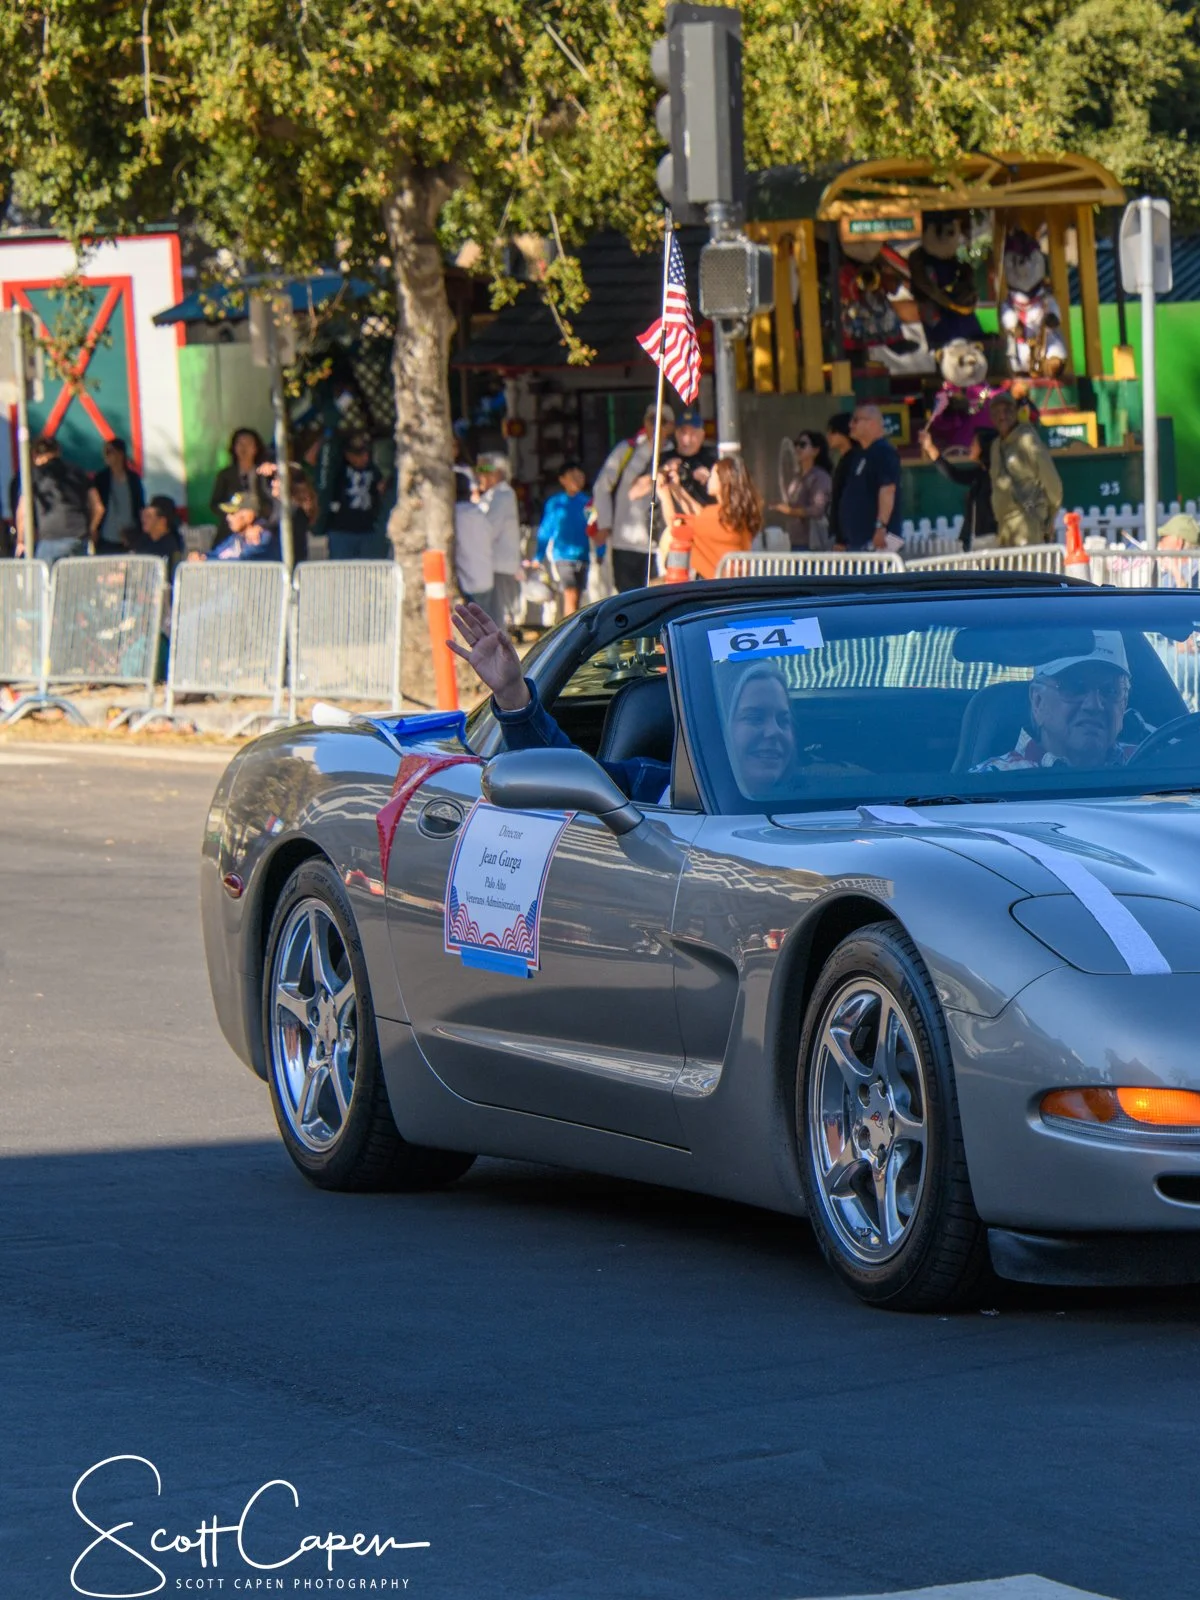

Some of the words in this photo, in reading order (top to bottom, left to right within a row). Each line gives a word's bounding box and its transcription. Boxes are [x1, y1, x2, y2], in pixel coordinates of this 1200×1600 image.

[729, 628, 792, 652] 64
[499, 824, 524, 840] Director
[478, 847, 497, 867] Jean
[498, 849, 522, 874] Gurga
[484, 876, 496, 889] Palo
[496, 878, 507, 891] Alto
[465, 890, 485, 905] Veterans
[486, 895, 521, 911] Administration
